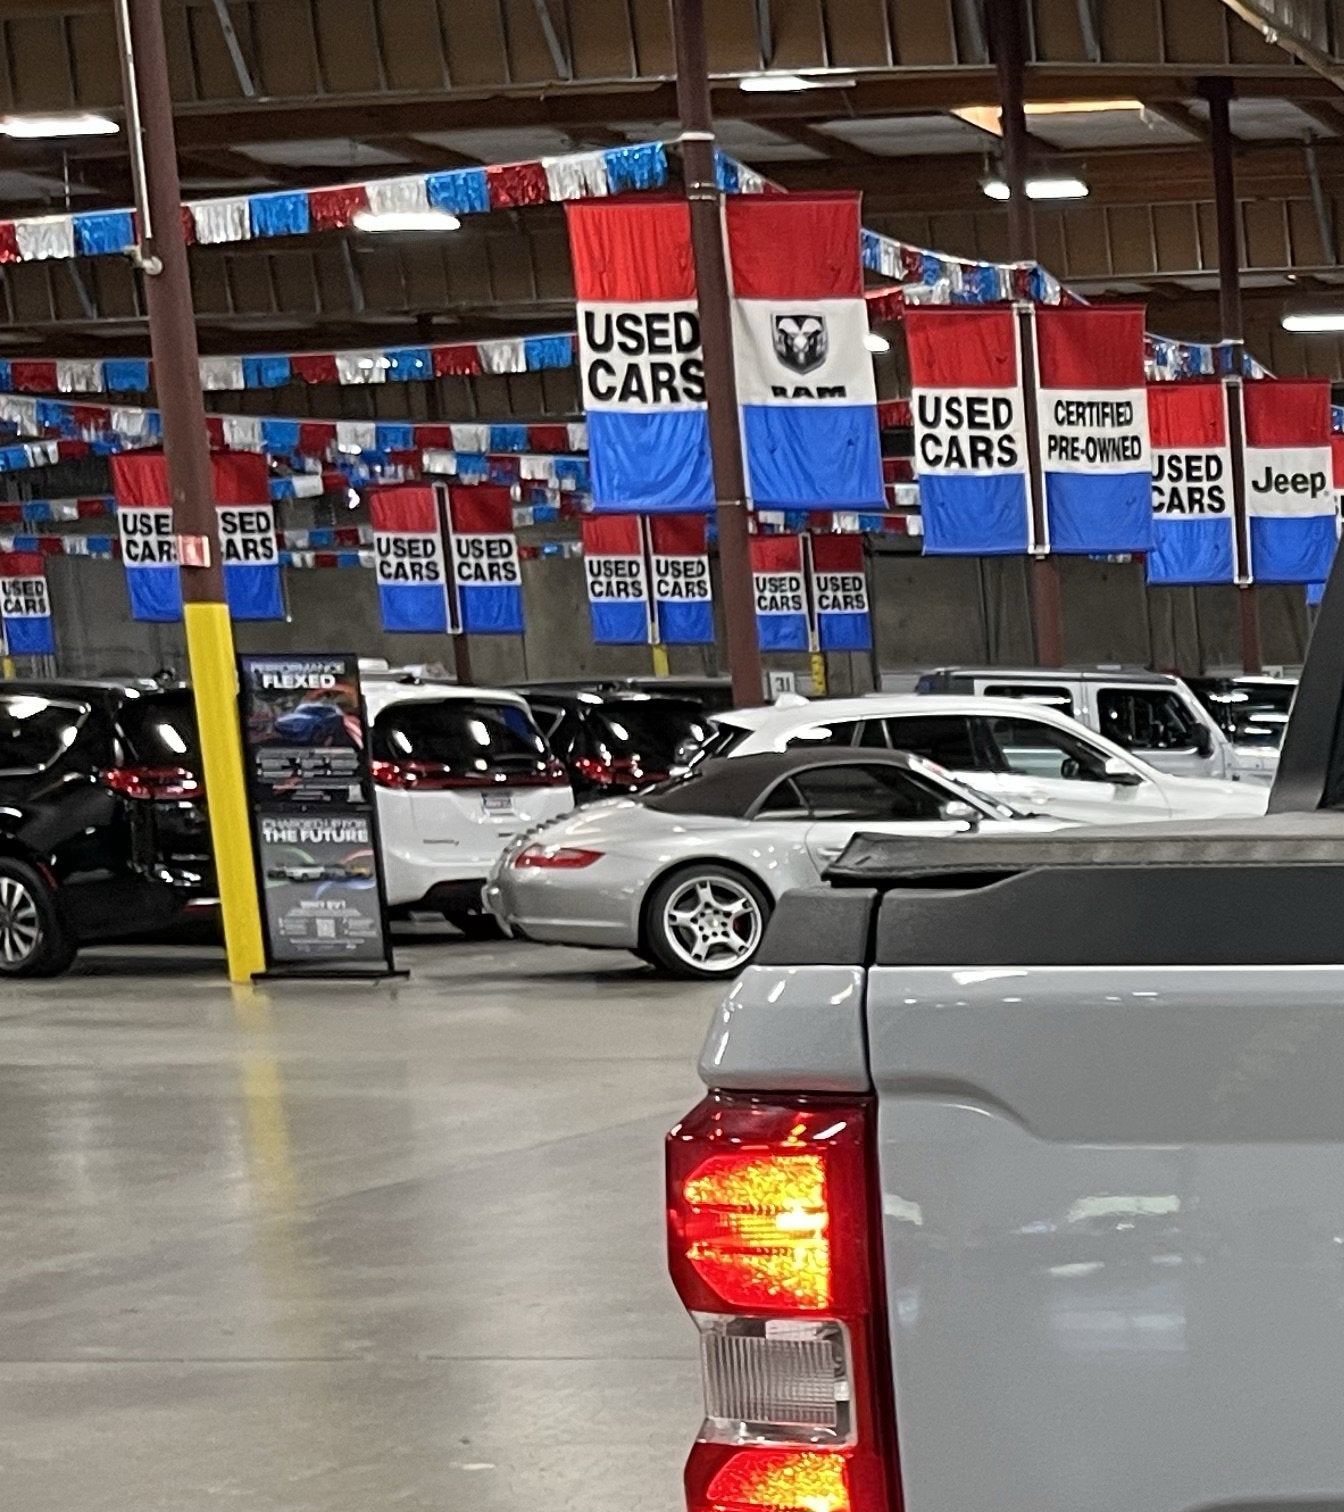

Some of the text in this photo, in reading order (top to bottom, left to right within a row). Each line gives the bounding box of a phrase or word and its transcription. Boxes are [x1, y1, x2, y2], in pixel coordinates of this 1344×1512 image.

[585, 311, 701, 356] USED
[588, 358, 706, 403] CARS
[771, 385, 846, 399] RAM
[918, 395, 1013, 430] USED
[1054, 400, 1133, 427] CERTIFIED
[920, 433, 1018, 468] CARS
[1048, 434, 1142, 463] PRE-OWNED
[1252, 467, 1326, 498] Jeep
[1152, 485, 1226, 513] CARS
[122, 513, 170, 535] USE
[221, 511, 271, 534] SED
[126, 539, 177, 562] CAR
[222, 537, 274, 560] ARS
[377, 537, 436, 558] USED
[456, 538, 513, 558] USED
[379, 560, 440, 581] CARS
[457, 562, 517, 581] CARS
[588, 560, 640, 578] USED
[655, 559, 706, 578] USED
[2, 581, 44, 596] USED
[590, 580, 643, 598] CARS
[657, 579, 708, 598] CARS
[755, 577, 800, 593] USED
[816, 576, 863, 592] USED
[4, 598, 46, 614] CARS
[757, 595, 802, 611] CARS
[818, 595, 865, 610] CARS
[263, 673, 336, 689] FLEXED
[262, 829, 368, 843] THE FUTURE
